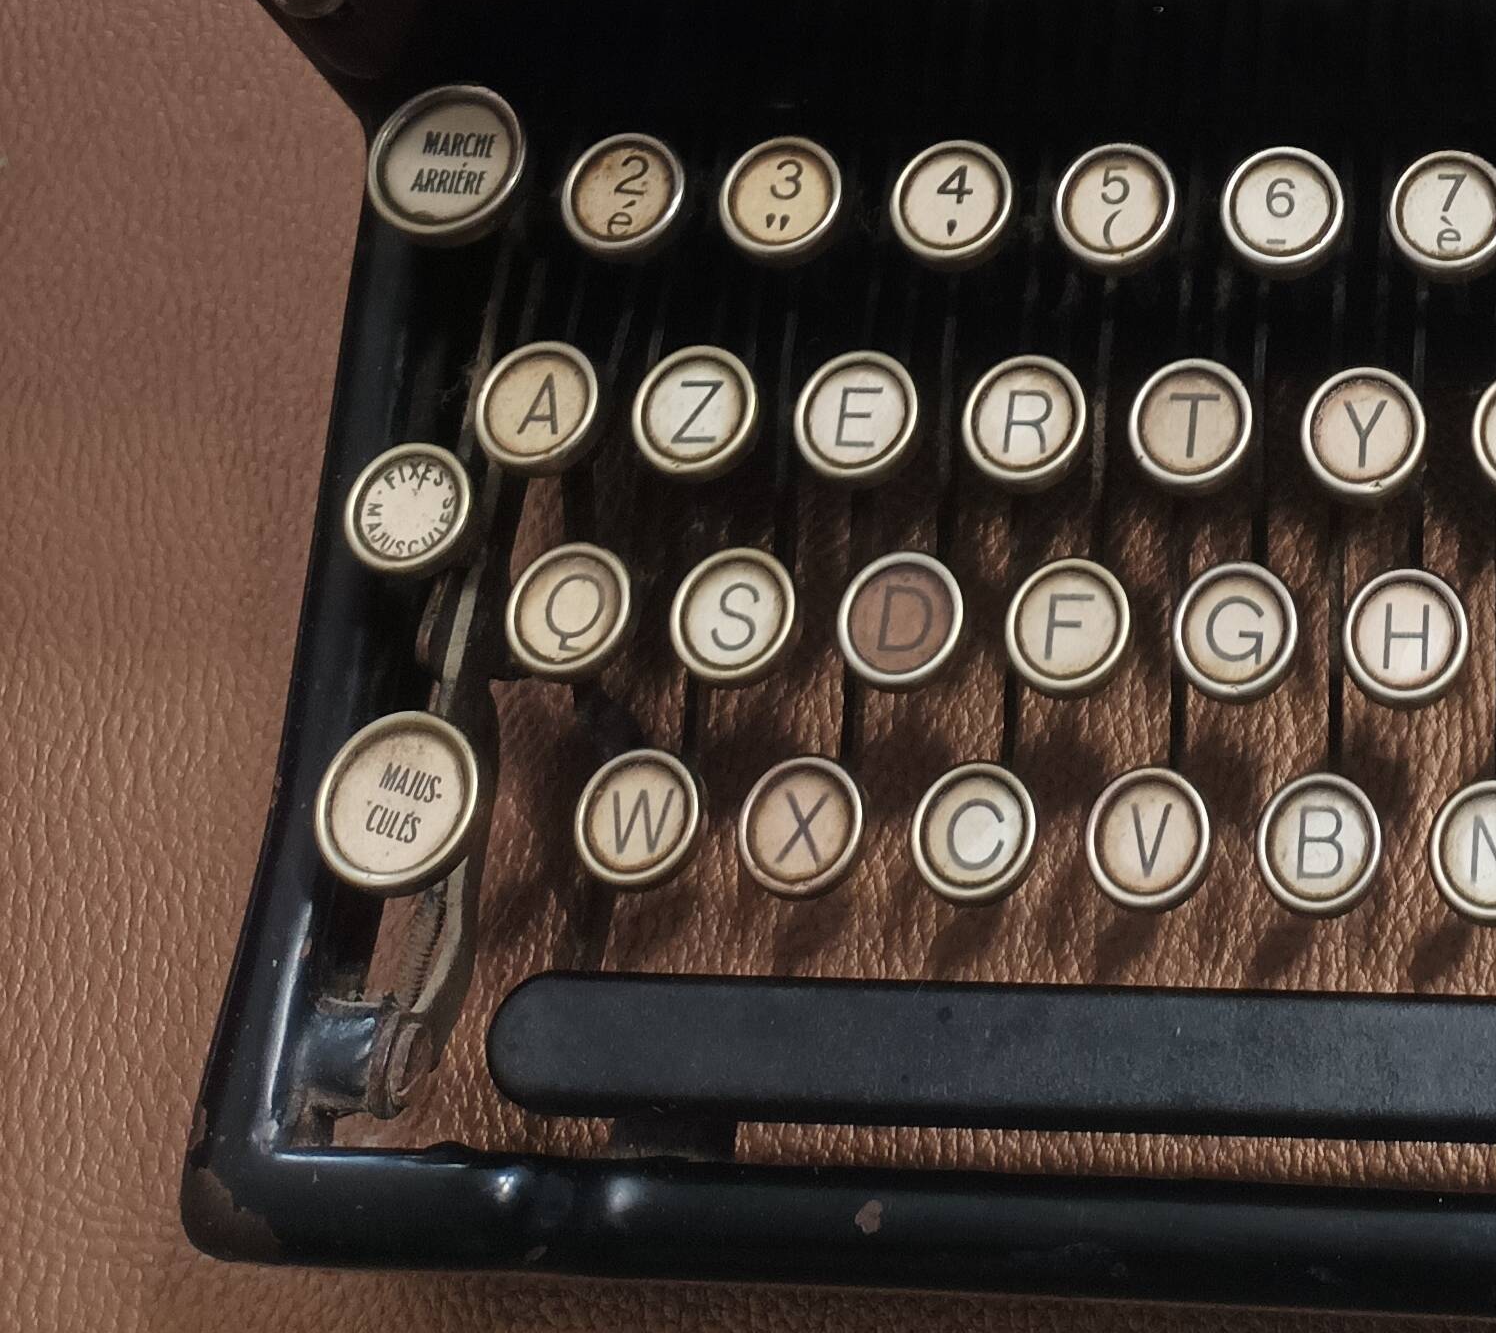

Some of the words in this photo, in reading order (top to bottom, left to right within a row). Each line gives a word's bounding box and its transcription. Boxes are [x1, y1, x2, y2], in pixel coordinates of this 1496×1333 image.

[422, 130, 497, 159] MARCHE
[613, 155, 650, 195] 2
[769, 159, 803, 200] 3
[937, 164, 973, 204] 4
[1101, 165, 1131, 205] 5
[1265, 178, 1296, 218] 6
[1437, 173, 1468, 213] 7
[607, 199, 633, 235] é
[1437, 216, 1463, 253] è
[517, 372, 560, 436] A
[671, 380, 724, 444] Z
[835, 386, 884, 448] E
[1002, 389, 1054, 454] R
[1170, 392, 1221, 458] T
[1343, 399, 1387, 468] Y
[365, 495, 457, 557] MAJUSCULES
[545, 573, 607, 652] Q
[710, 581, 761, 652] S
[876, 584, 932, 653] D
[1044, 593, 1095, 661] F
[1205, 595, 1265, 665] G
[1382, 602, 1430, 671] H
[379, 761, 442, 803] MAJUS-
[366, 804, 421, 843] CULES
[612, 788, 675, 855] W
[774, 788, 830, 864] X
[947, 798, 1005, 871] C
[1131, 802, 1173, 878] V
[1296, 805, 1344, 880] B
